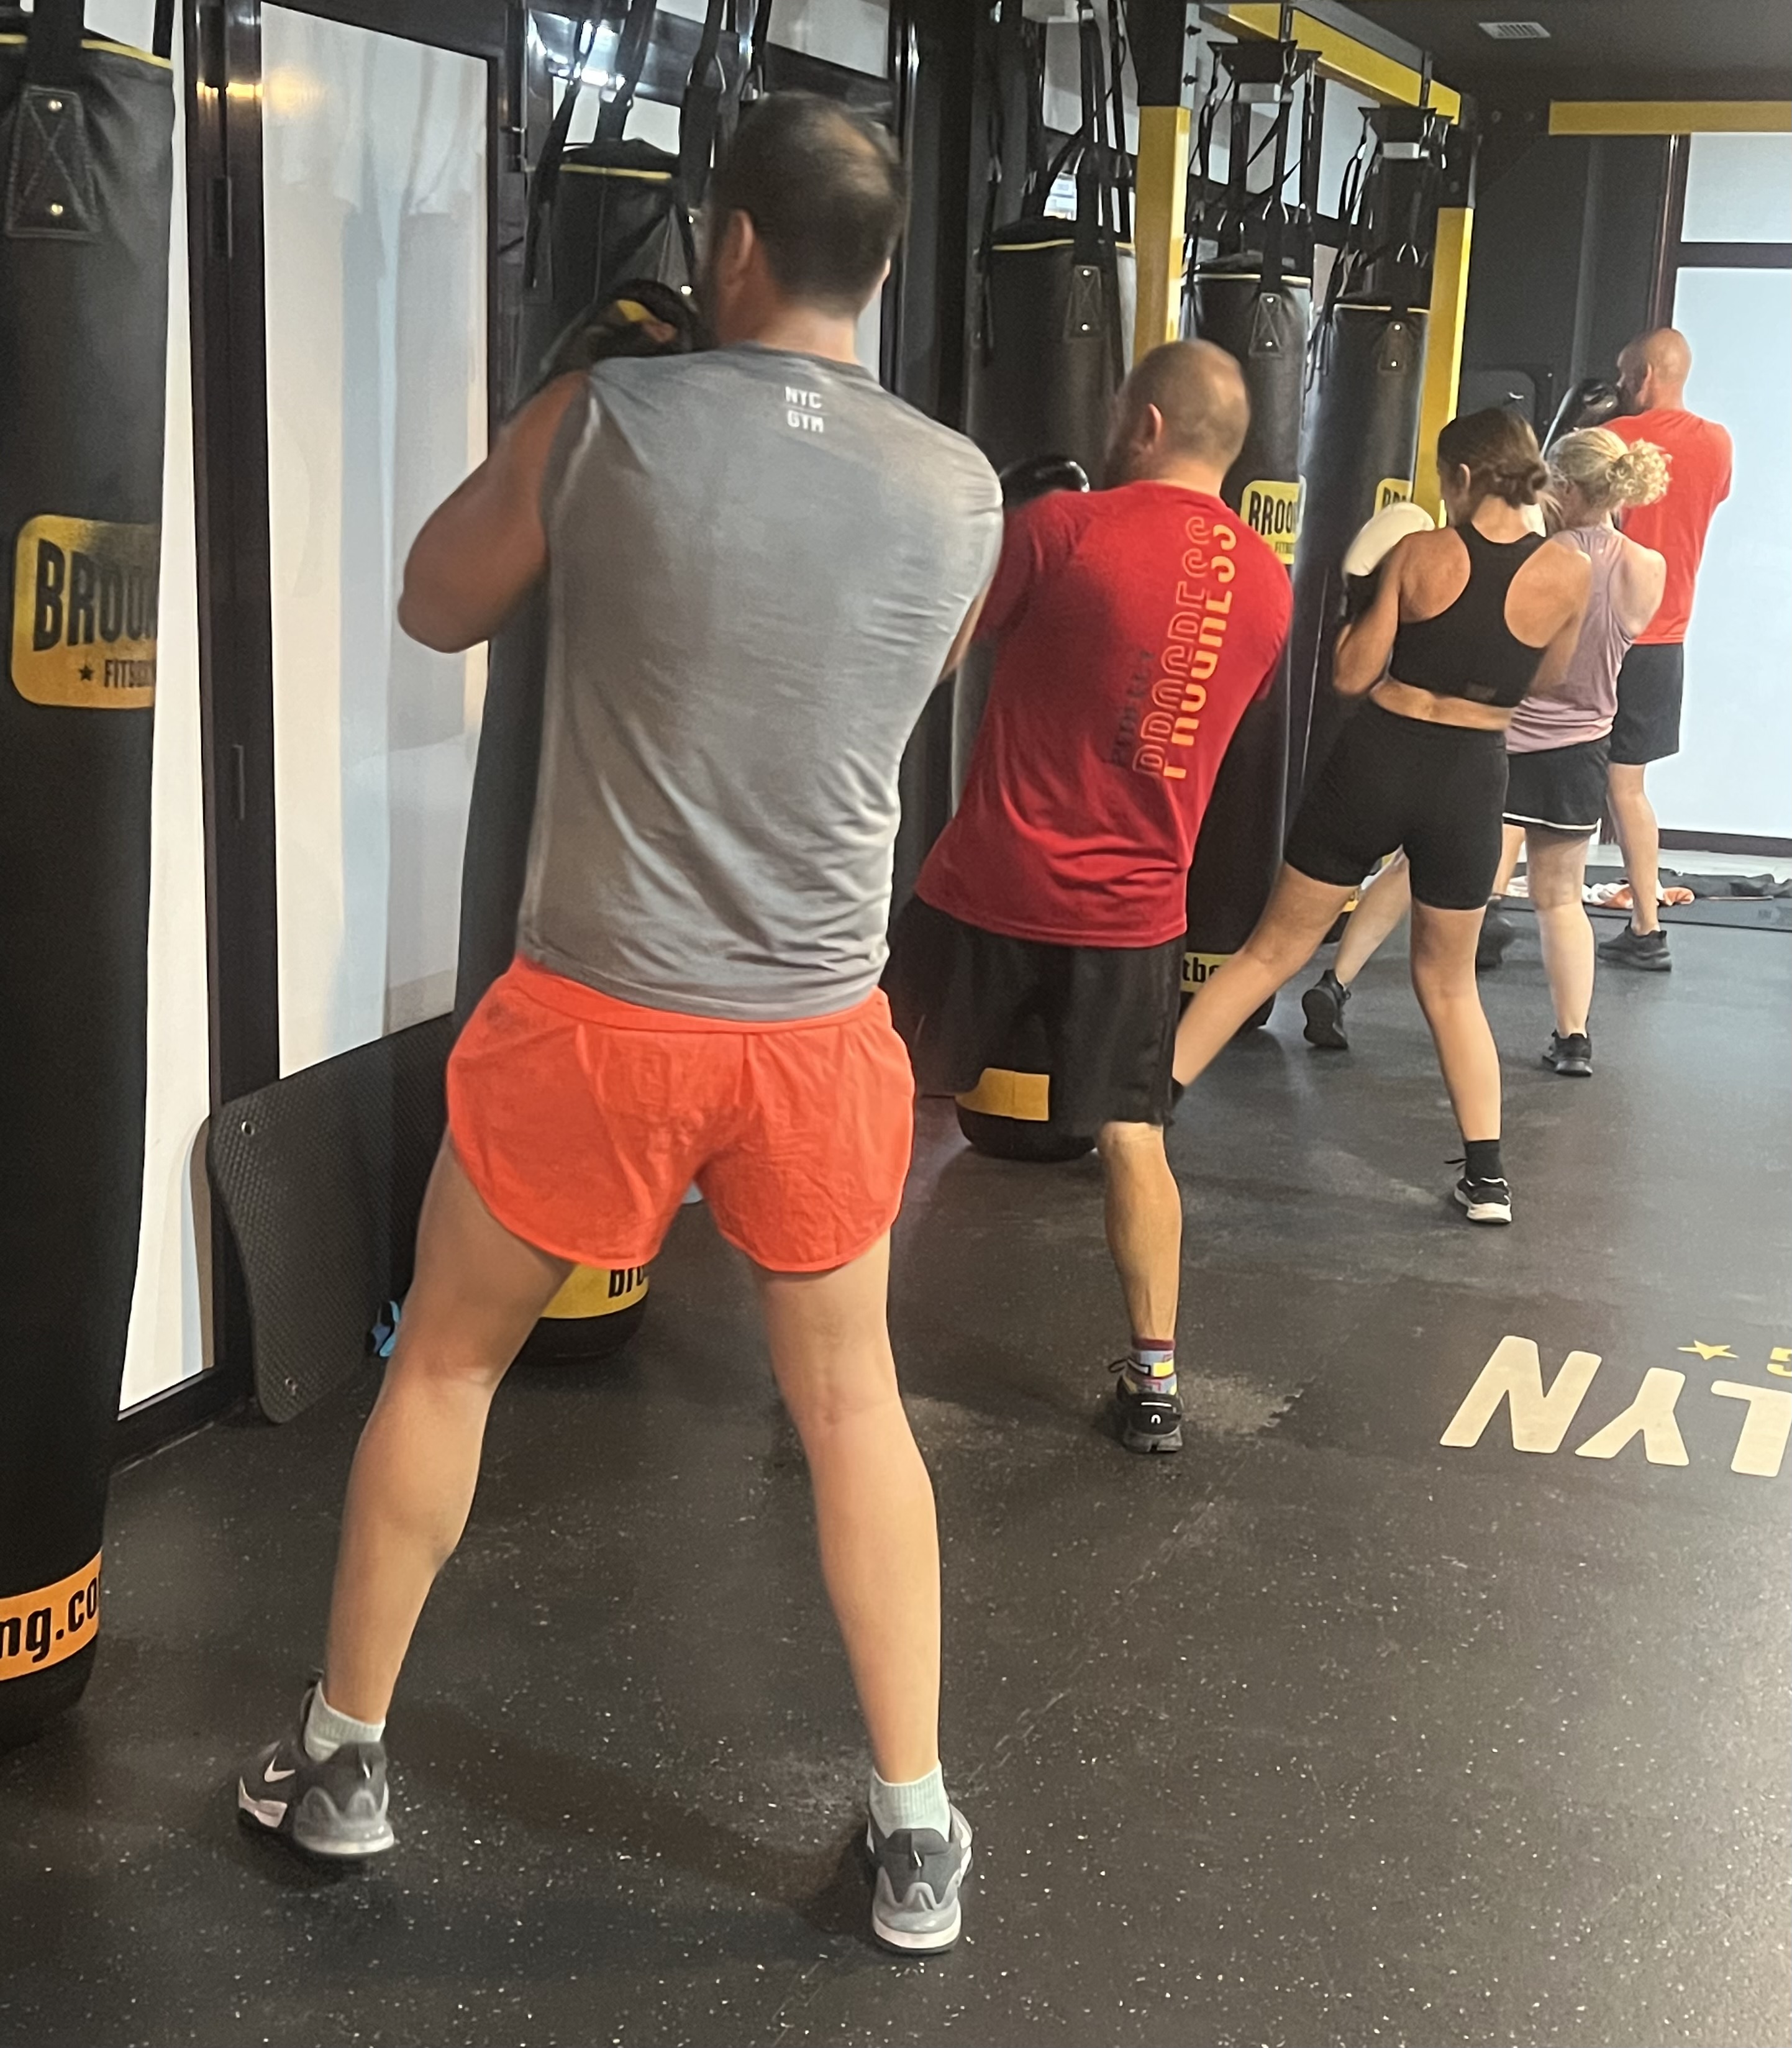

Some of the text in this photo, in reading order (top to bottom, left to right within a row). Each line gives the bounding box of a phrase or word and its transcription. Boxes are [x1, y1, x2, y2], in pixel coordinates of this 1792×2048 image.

[785, 386, 822, 409] NYC
[787, 409, 824, 433] GYM
[1132, 516, 1237, 780] PROGRESS
